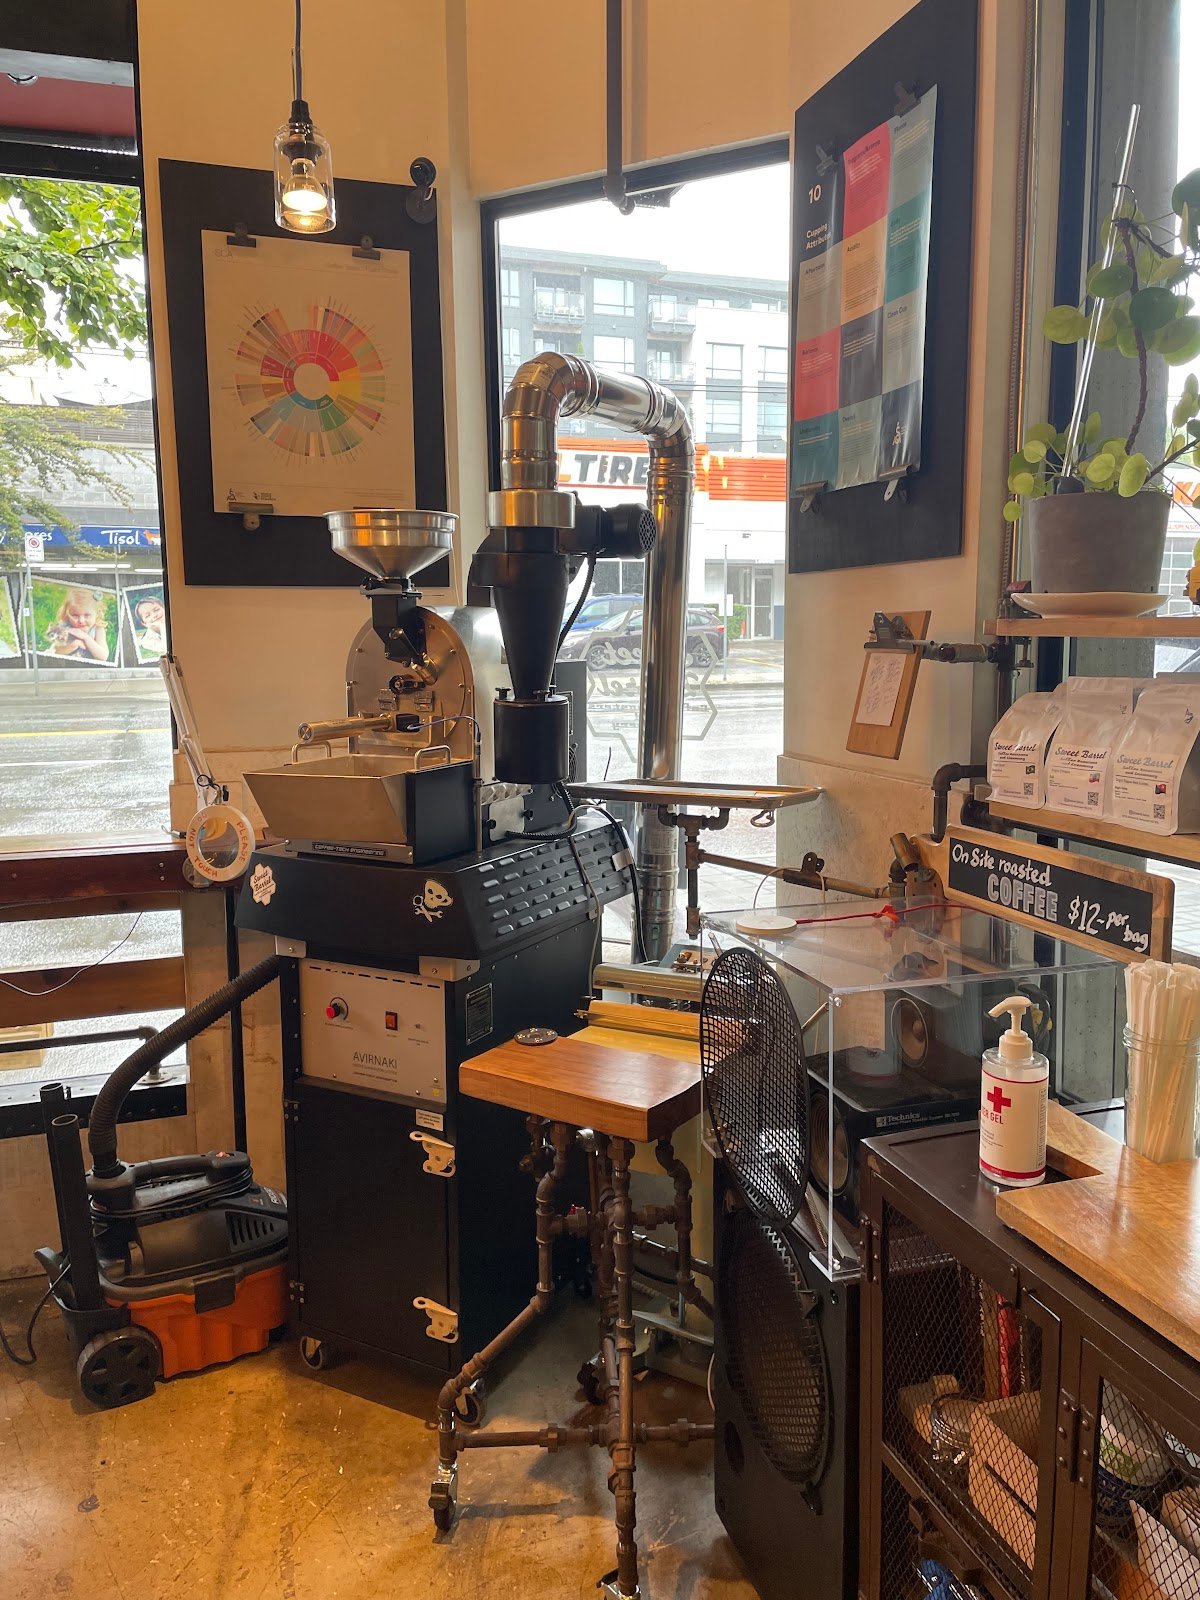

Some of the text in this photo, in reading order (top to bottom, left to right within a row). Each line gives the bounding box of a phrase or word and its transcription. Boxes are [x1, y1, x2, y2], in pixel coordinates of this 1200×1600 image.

[808, 184, 822, 204] 10
[806, 223, 828, 239] Cupping
[574, 453, 650, 484] TIRE
[100, 529, 141, 545] Tisol
[994, 742, 1013, 751] Sweet
[1055, 746, 1107, 759] Sweet Barrel
[1117, 754, 1174, 769] Sweet Barrel
[236, 821, 249, 861] PLEASE
[194, 855, 217, 877] TOUCH
[952, 843, 1053, 887] On Site roasted
[987, 873, 1059, 922] COFFEE
[1122, 924, 1149, 953] bag
[352, 1051, 398, 1069] AVIRNAKI
[886, 1112, 920, 1122] Technics
[990, 1112, 1004, 1125] GEL
